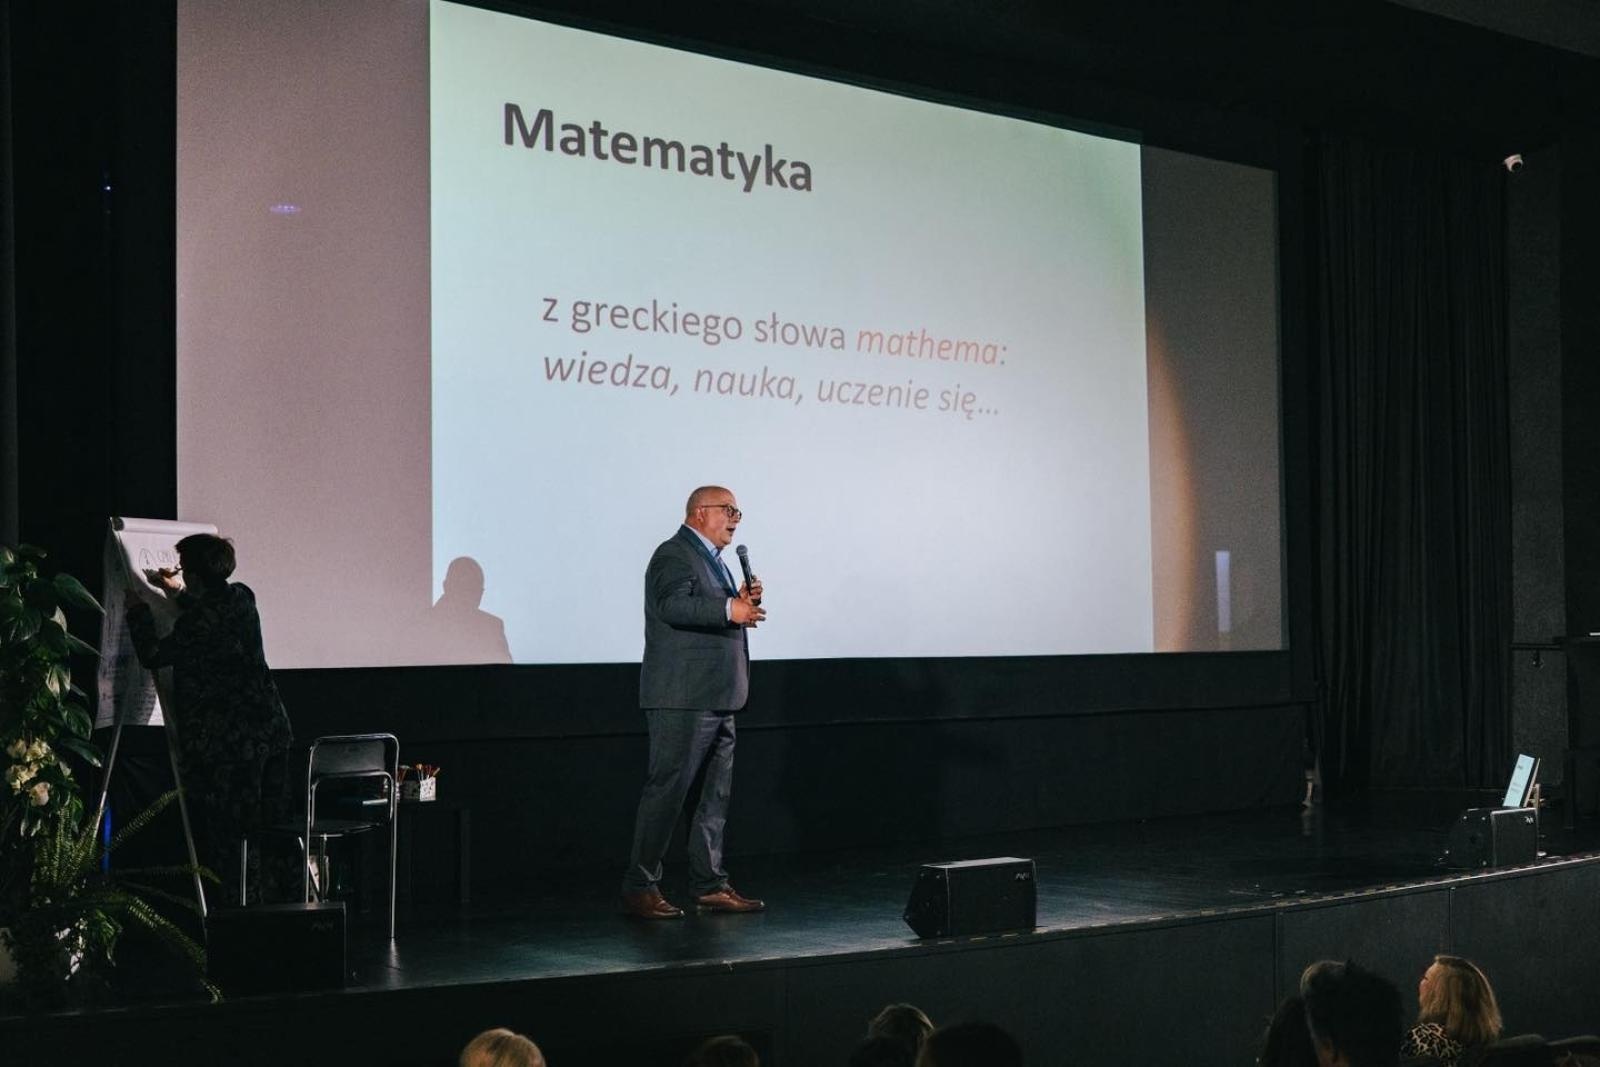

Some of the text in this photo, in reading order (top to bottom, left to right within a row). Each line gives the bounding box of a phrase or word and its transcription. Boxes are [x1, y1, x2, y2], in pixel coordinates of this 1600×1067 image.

[504, 102, 812, 193] Matematyka
[542, 297, 1007, 366] z greckiego słowa mathema:
[544, 351, 999, 420] wiedza, nauka, uczenie się...
